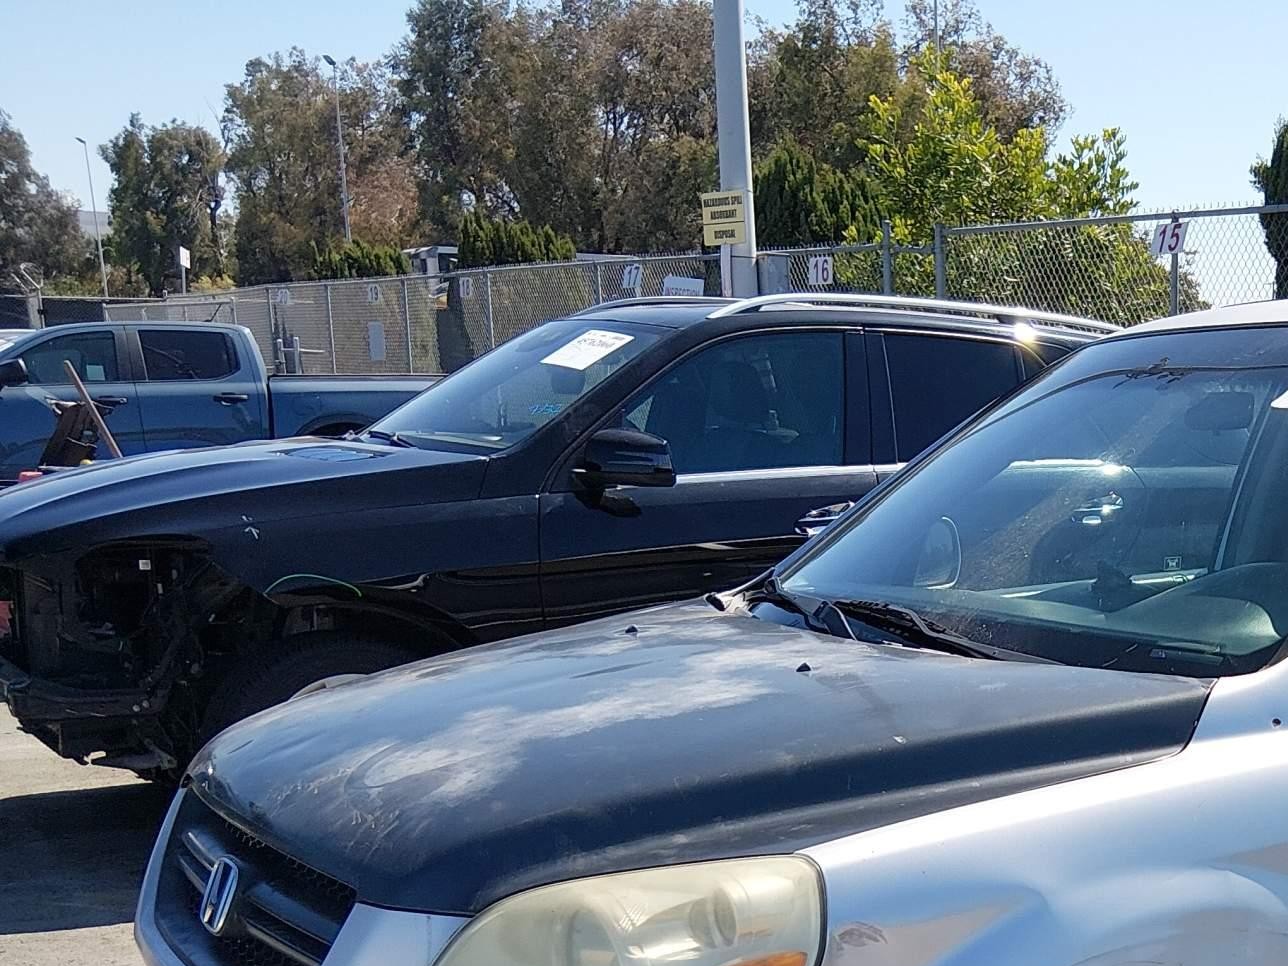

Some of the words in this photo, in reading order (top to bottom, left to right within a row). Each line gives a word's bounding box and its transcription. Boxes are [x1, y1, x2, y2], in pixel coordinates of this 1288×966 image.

[1159, 224, 1182, 252] 15
[627, 266, 640, 286] 17
[813, 258, 829, 283] 16
[370, 286, 379, 301] 19
[462, 279, 471, 296] 18
